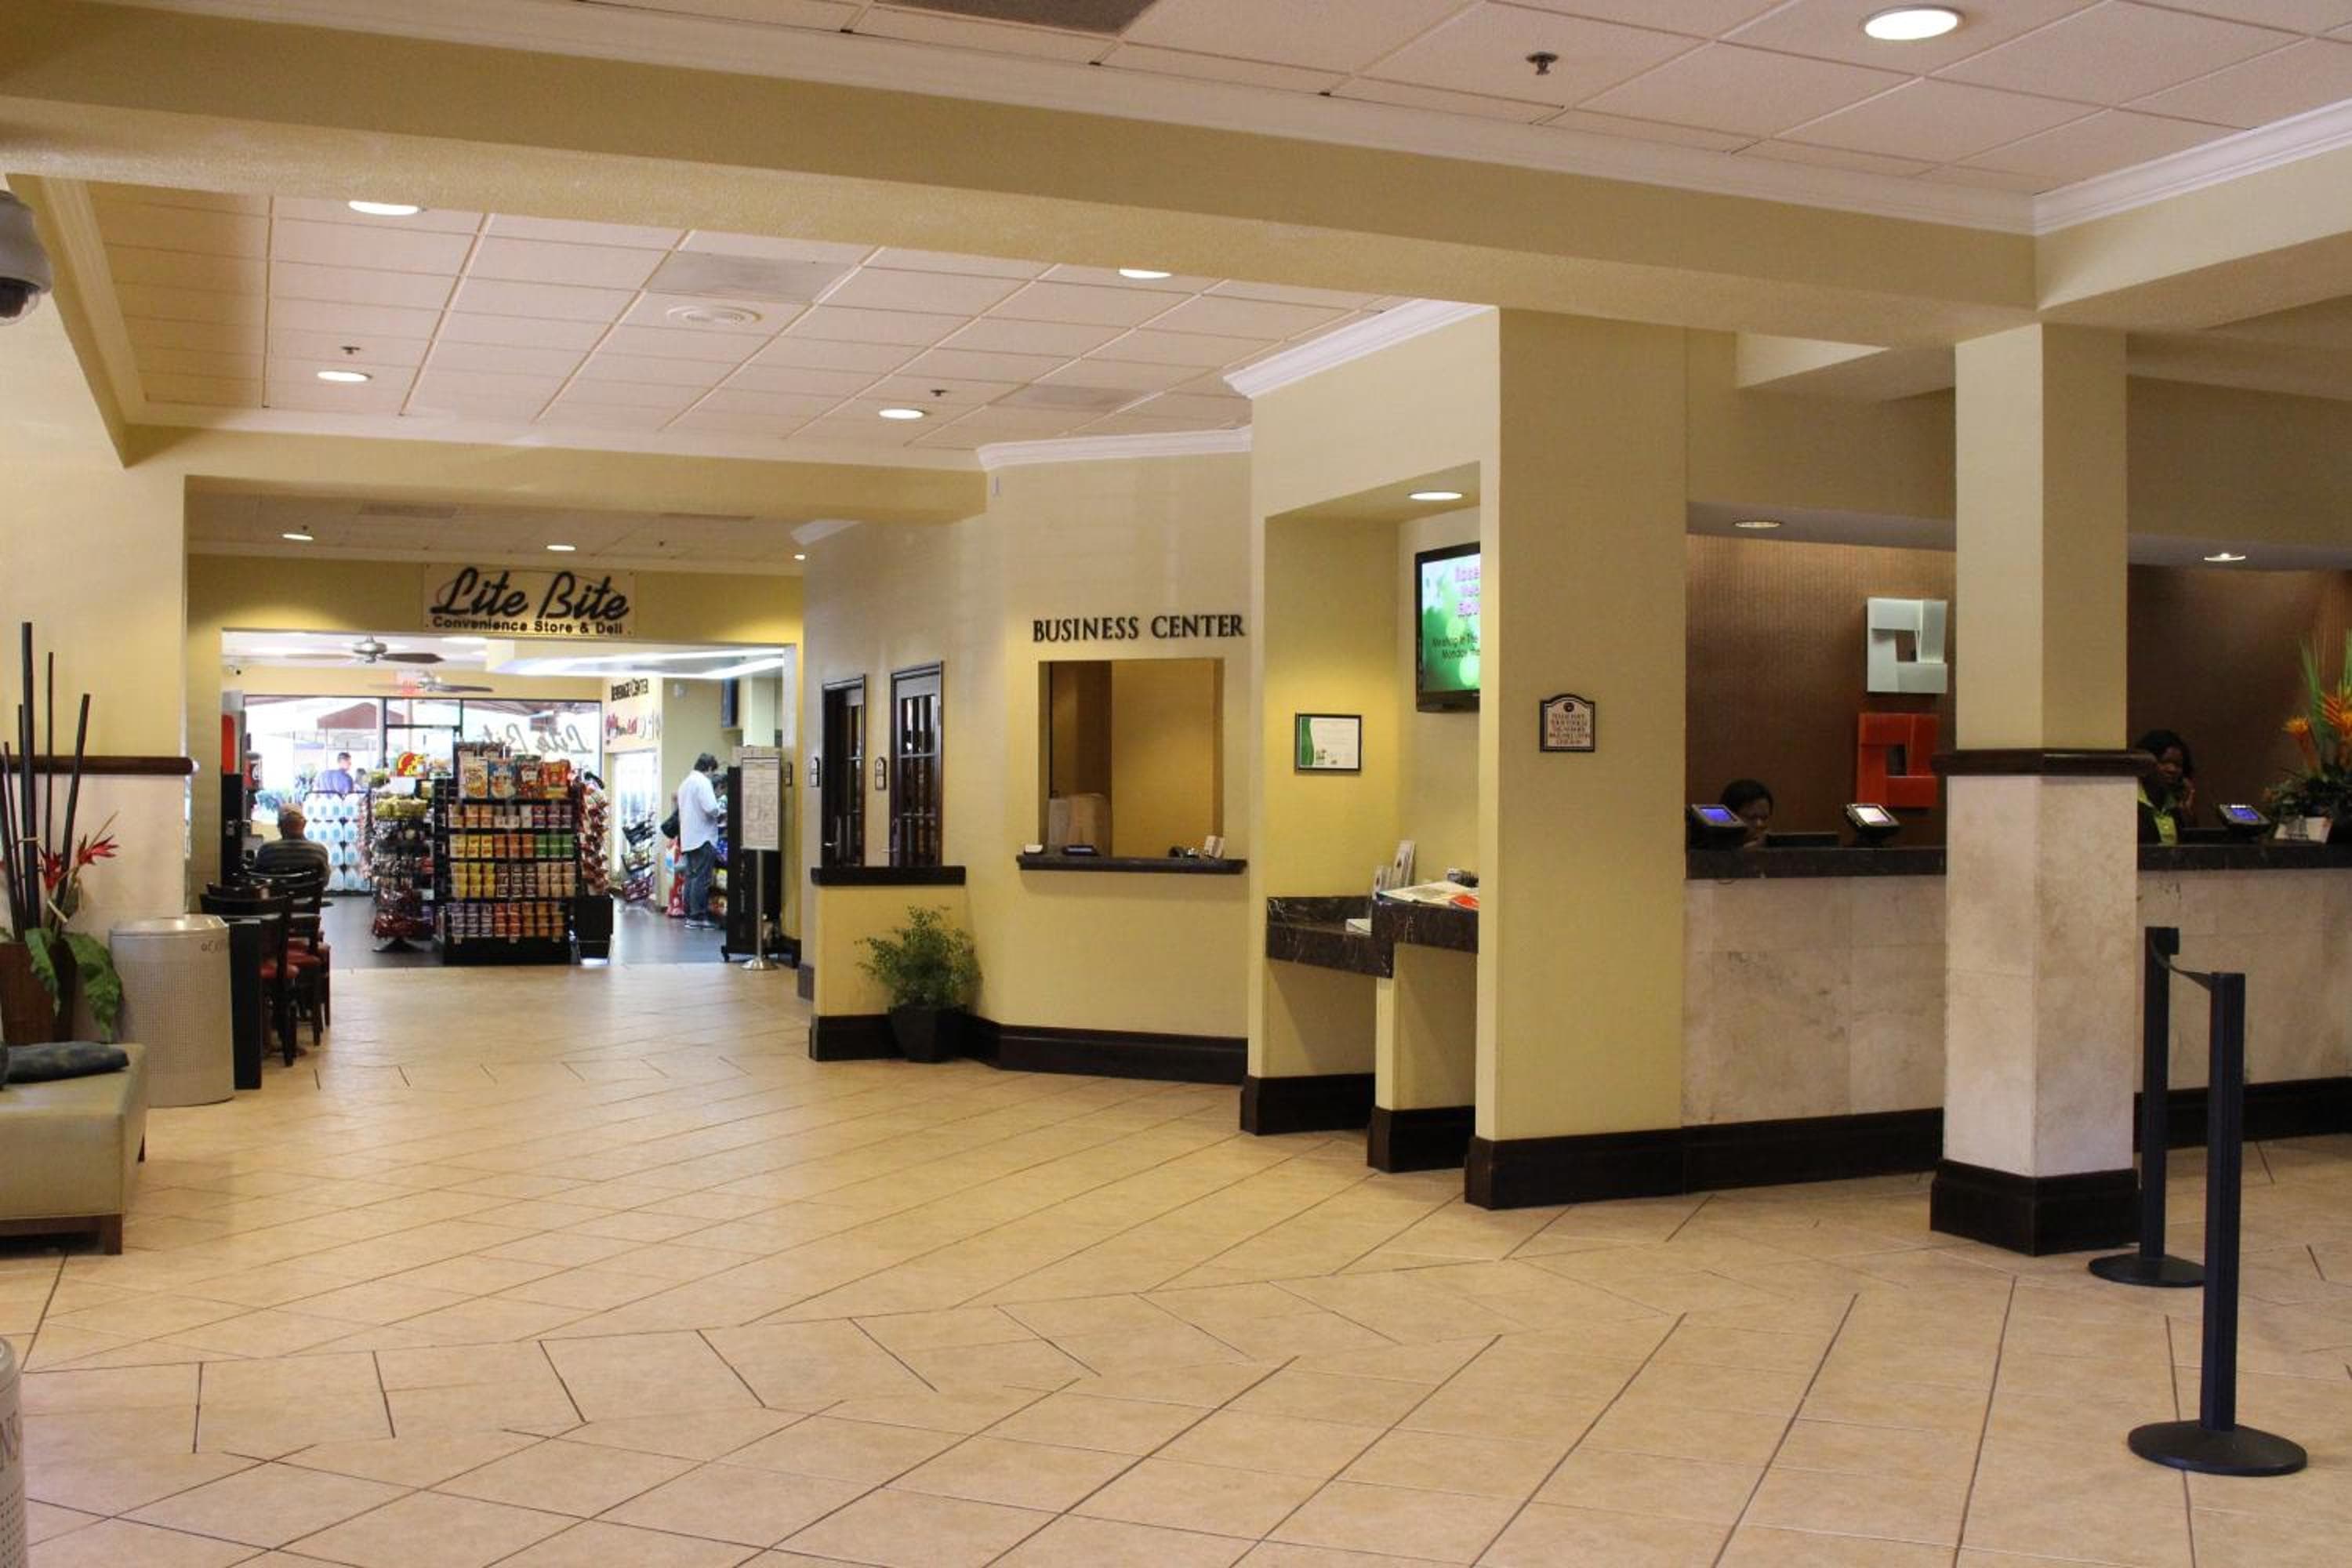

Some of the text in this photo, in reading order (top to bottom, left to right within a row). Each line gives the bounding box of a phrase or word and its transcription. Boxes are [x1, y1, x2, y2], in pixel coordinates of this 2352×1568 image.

[429, 566, 630, 620] Lite Bite
[433, 616, 622, 634] Convenience Store & Deli
[1033, 614, 1246, 642] BUSINESS CENTER
